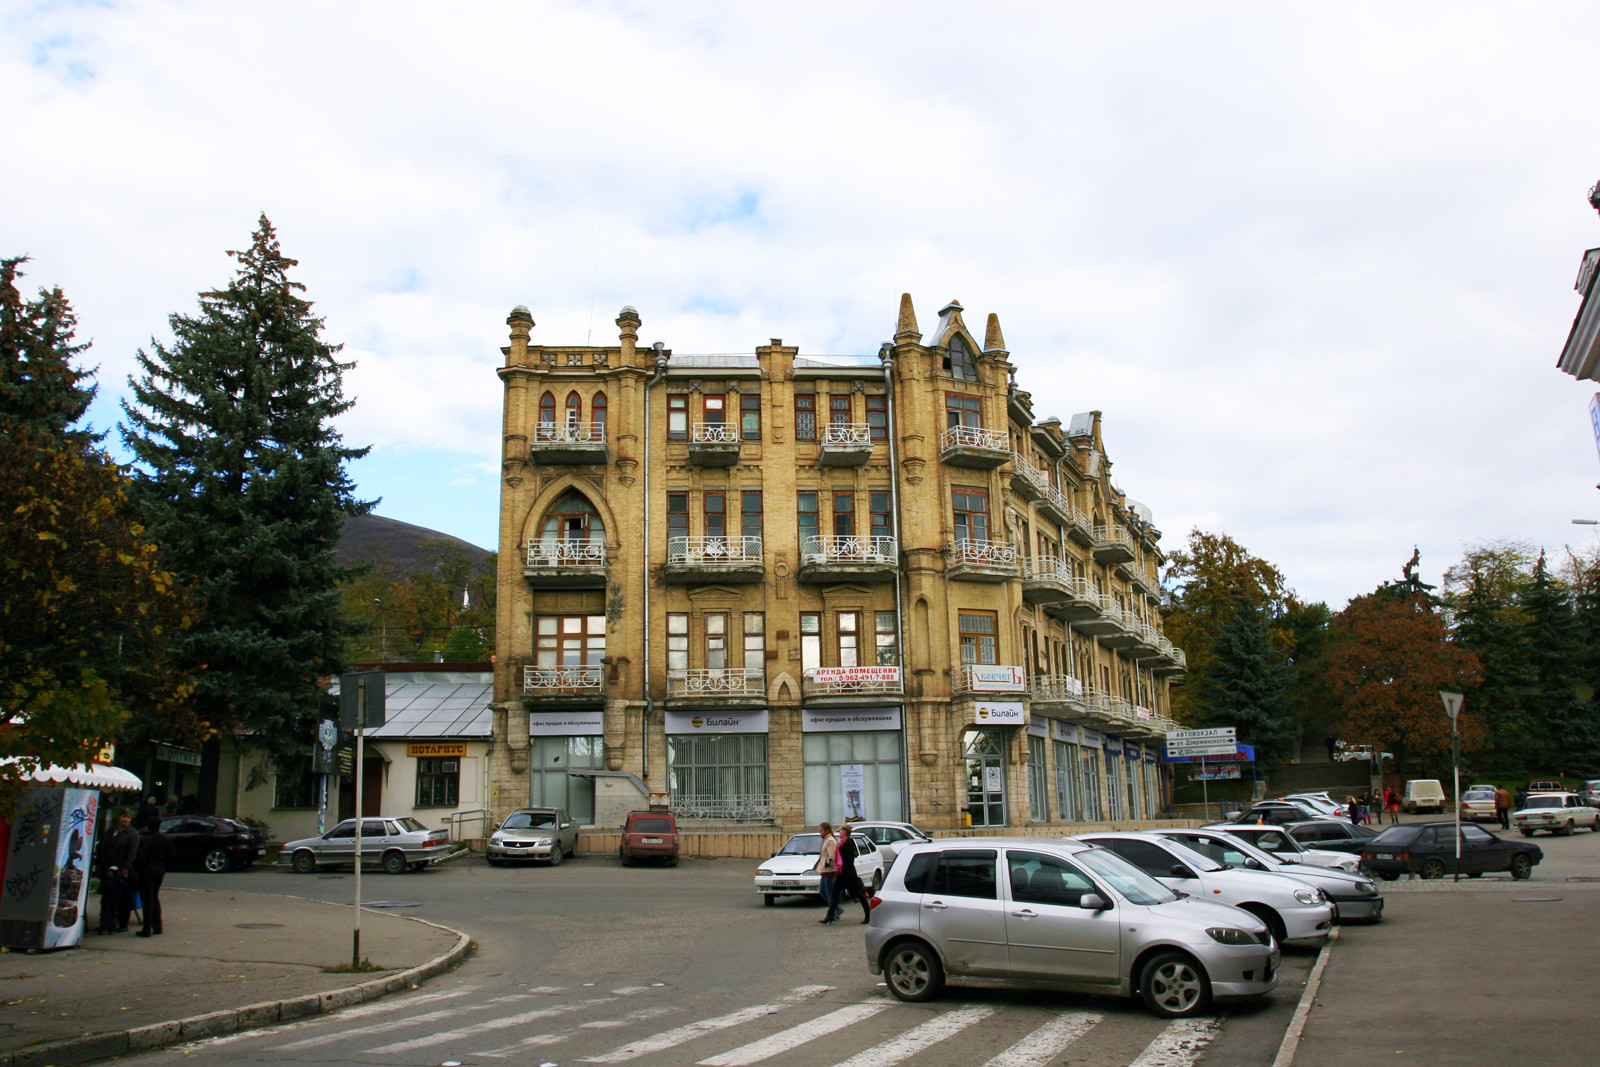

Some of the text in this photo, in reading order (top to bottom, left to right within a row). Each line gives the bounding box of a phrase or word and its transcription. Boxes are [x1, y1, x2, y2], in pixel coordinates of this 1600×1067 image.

[991, 709, 1019, 717] Билайн
[706, 718, 739, 726] Билайн
[411, 745, 463, 754] НОТАРИУС
